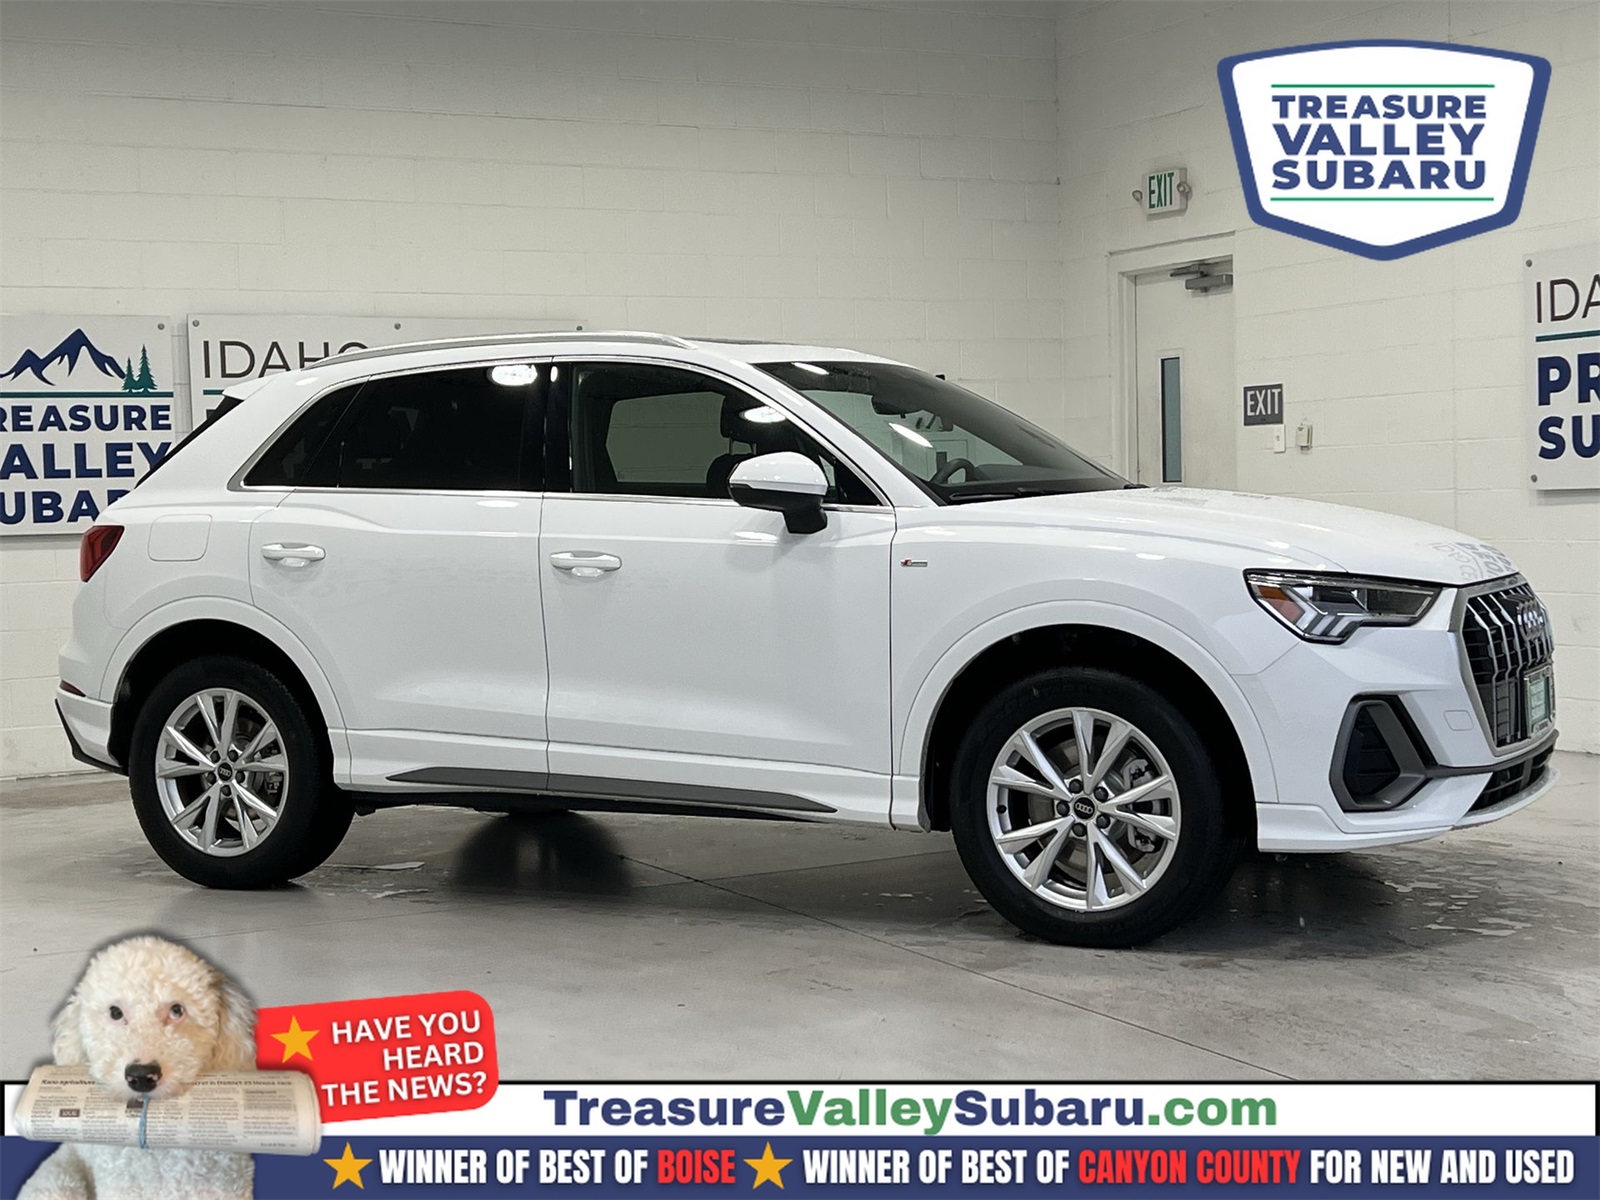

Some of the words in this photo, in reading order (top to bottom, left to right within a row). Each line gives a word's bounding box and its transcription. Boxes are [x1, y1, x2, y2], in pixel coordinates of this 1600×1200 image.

[1148, 172, 1175, 209] EXIT
[1536, 273, 1600, 324] IDA
[203, 340, 369, 379] IDAH
[1537, 352, 1600, 406] PR
[1246, 388, 1282, 417] EXIT
[1538, 414, 1600, 460] SU
